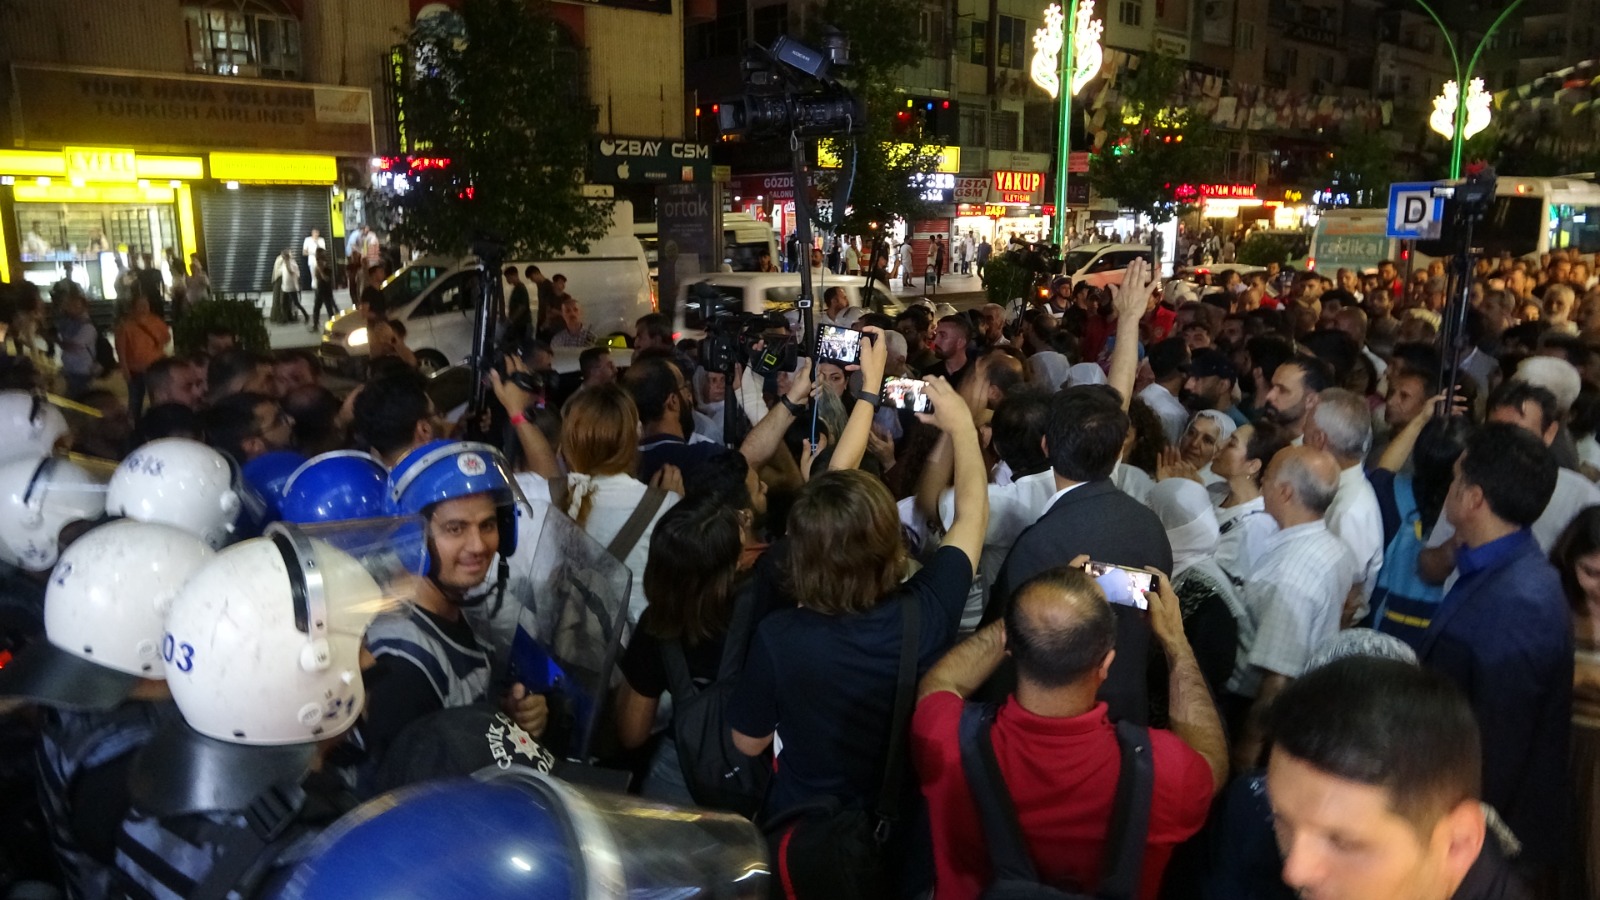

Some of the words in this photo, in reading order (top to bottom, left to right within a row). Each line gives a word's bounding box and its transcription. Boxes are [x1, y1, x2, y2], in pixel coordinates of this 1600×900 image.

[153, 83, 217, 102] HAVA
[96, 101, 199, 120] TURKISH
[205, 106, 305, 126] AIRLINES
[671, 142, 709, 159] GSM
[996, 171, 1040, 192] YAKUP
[955, 188, 983, 198] GSM
[664, 194, 708, 217] ortak
[1404, 196, 1427, 224] D
[1319, 240, 1384, 256] radikal
[162, 631, 195, 672] 03
[485, 722, 514, 769] ÇEVİK
